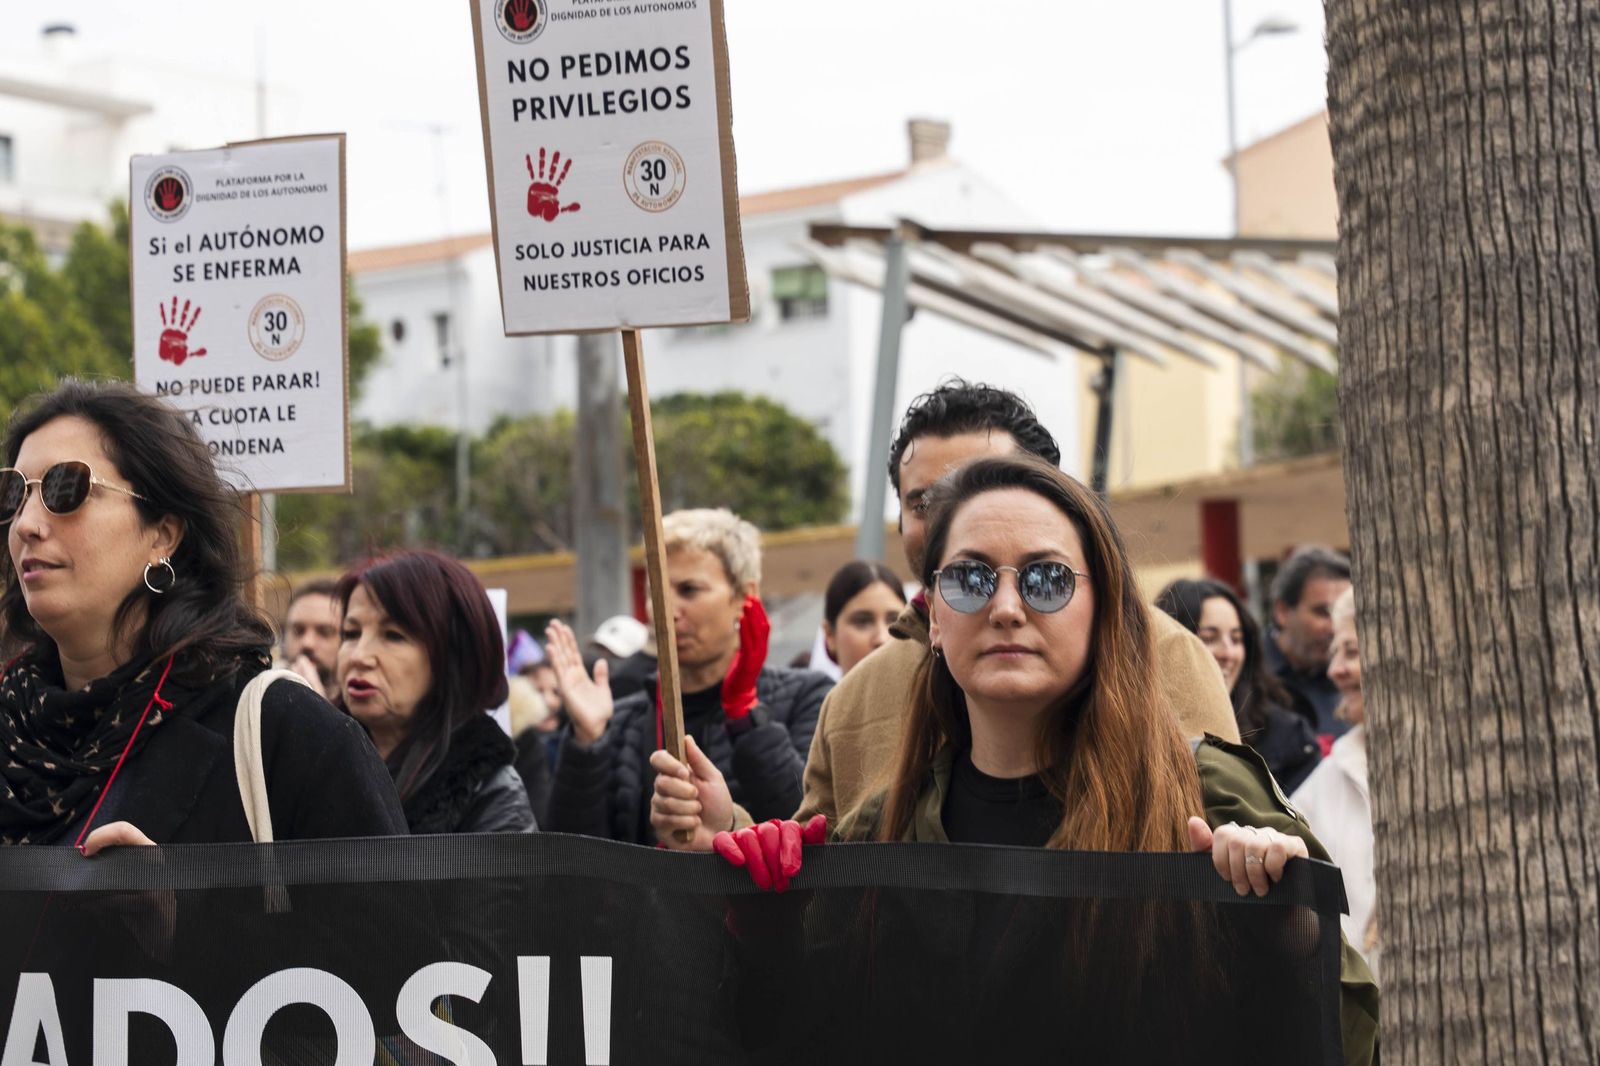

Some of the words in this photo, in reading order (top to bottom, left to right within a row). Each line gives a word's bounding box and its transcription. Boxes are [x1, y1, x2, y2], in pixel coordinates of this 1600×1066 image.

[551, 10, 597, 22] DIGNIDAD
[600, 7, 611, 17] DE
[614, 5, 632, 16] LOS
[507, 57, 550, 84] NO
[560, 45, 691, 79] PEDIMOS
[512, 85, 692, 122] PRIVILEGIOS
[215, 175, 272, 187] PLATAFORMA
[274, 173, 292, 182] POR
[294, 172, 305, 181] LA
[640, 158, 667, 182] 30
[195, 191, 238, 202] DIGNIDAD
[240, 189, 250, 199] DE
[253, 187, 269, 198] LOS
[649, 182, 660, 196] N
[149, 236, 166, 256] Si
[175, 234, 191, 254] el
[199, 224, 324, 252] AUTÓNOMO
[515, 241, 565, 261] SOLO
[570, 236, 653, 258] JUSTICIA
[658, 233, 710, 251] PARA
[173, 264, 195, 283] SE
[203, 256, 301, 281] ENFERMA
[523, 270, 621, 292] NUESTROS
[627, 265, 705, 286] OFICIOS
[264, 310, 287, 333] 30
[271, 333, 281, 346] N
[156, 379, 183, 397] NO
[190, 375, 245, 395] PUEDE
[252, 370, 320, 391] PARAR!
[209, 406, 271, 425] CUOTA
[278, 404, 296, 421] LE
